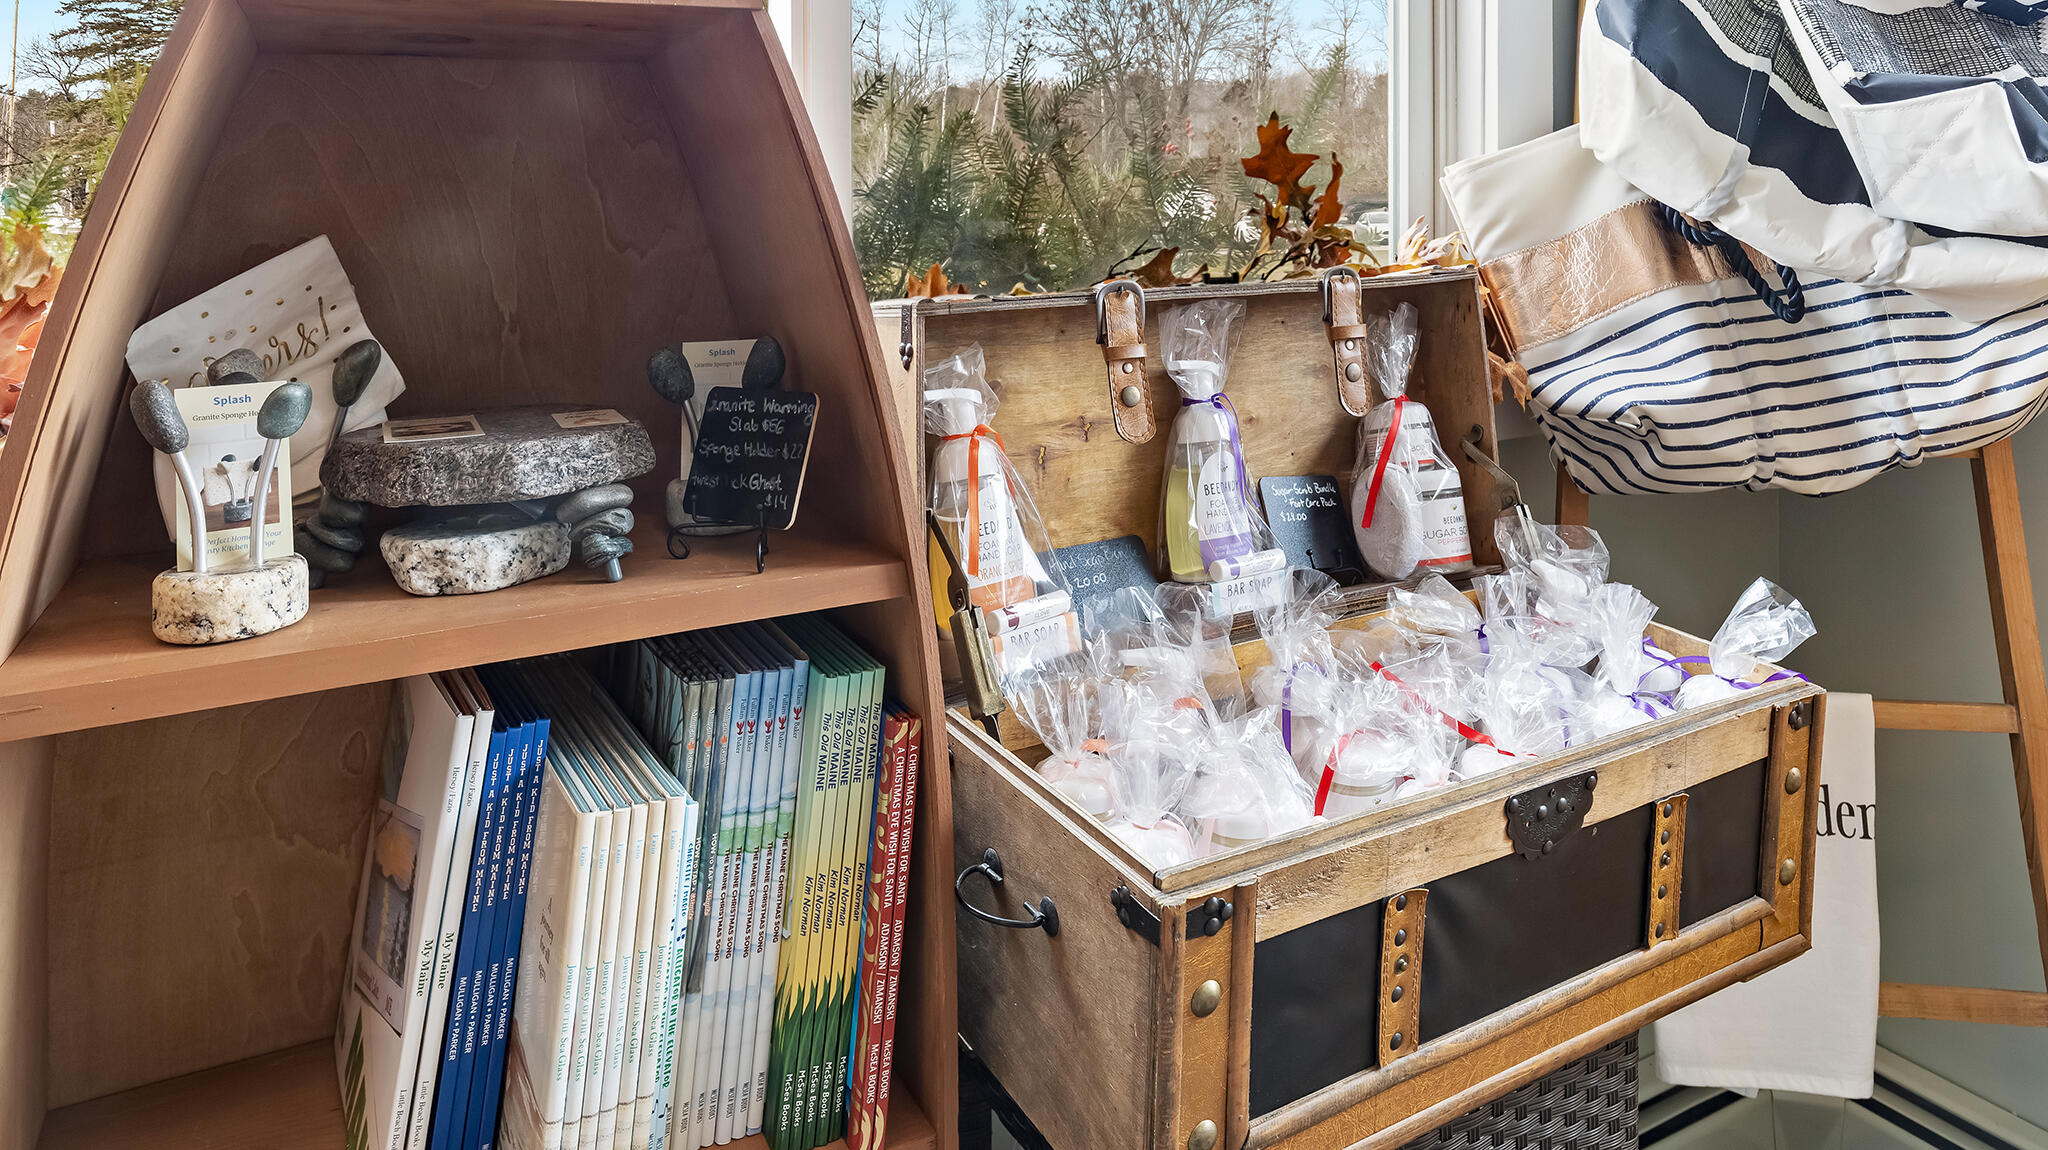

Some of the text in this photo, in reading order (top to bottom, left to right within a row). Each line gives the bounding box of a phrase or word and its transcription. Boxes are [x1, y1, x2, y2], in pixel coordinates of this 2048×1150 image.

[708, 348, 736, 358] Splash
[192, 411, 248, 422] Granite Sponge
[213, 394, 251, 407] Splash
[728, 416, 758, 432] Slab
[763, 397, 815, 426] Warming
[698, 438, 741, 463] Sponge
[748, 472, 782, 490] Ghost
[764, 493, 788, 510] $14
[1271, 484, 1294, 503] Sugar
[1289, 498, 1305, 508] Foot
[1226, 582, 1246, 598] BAR
[1010, 631, 1031, 648] BAR
[816, 712, 832, 792] This Old MAINE
[828, 710, 844, 790] This Old MAINE
[840, 707, 856, 786] This Old MAINE
[852, 705, 869, 784] This Old MAINE
[866, 702, 882, 780] This Old MAINE
[446, 766, 460, 813] Hersey/Fazio
[466, 760, 480, 807] Hersey/Fazio
[472, 754, 500, 912] JUST A KID FROM MAINE
[488, 748, 514, 906] JUST A KID FROM MAINE
[504, 744, 529, 900] JUST A KID FROM MAINE
[518, 740, 544, 895] JUST A KID FROM MAINE
[710, 832, 718, 854] HOW
[884, 746, 906, 910] A CHRISTMAS EVE WISH FOR SANTA
[896, 744, 918, 906] A CHRISTMAS EVE WISH FOR SANTA
[733, 864, 741, 888] MAINE
[772, 832, 790, 944] THE MAINE CHRISTMAS SONG
[812, 872, 826, 934] Kim Norman
[826, 869, 839, 930] Kim Norman
[838, 866, 852, 926] Kim Norman
[853, 862, 866, 922] Kim Norman
[728, 890, 738, 936] CHRISTMAS
[800, 876, 814, 937] Kim Norman
[416, 940, 434, 997] My Maine
[438, 932, 455, 990] My Maine
[634, 950, 648, 984] Journey
[670, 948, 684, 1002] ALLIGATOR
[874, 922, 890, 1026] ADAMSON ZIMANSKI
[886, 919, 902, 1021] ADAMSON ZIMANSKI
[448, 976, 468, 1062] MULLIGAN PARKER
[464, 970, 483, 1054] MULLIGAN PARKER
[480, 963, 499, 1046] MULLIGAN PARKER
[496, 957, 514, 1040] MULLIGAN PARKER
[669, 1003, 678, 1016] IN
[630, 1038, 639, 1064] Glass
[632, 1020, 640, 1037] Sea
[668, 1018, 676, 1038] THE
[420, 1080, 430, 1100] Little
[662, 1040, 674, 1088] ELEVATOR
[820, 1062, 833, 1119] McSea Books
[835, 1056, 848, 1113] McSea Books
[866, 1074, 877, 1104] BOOKS
[879, 1070, 890, 1100] BOOKS
[398, 1088, 408, 1108] Little
[780, 1073, 794, 1132] McSea Books
[793, 1070, 806, 1128] McSea Books
[807, 1065, 820, 1123] McSea Books
